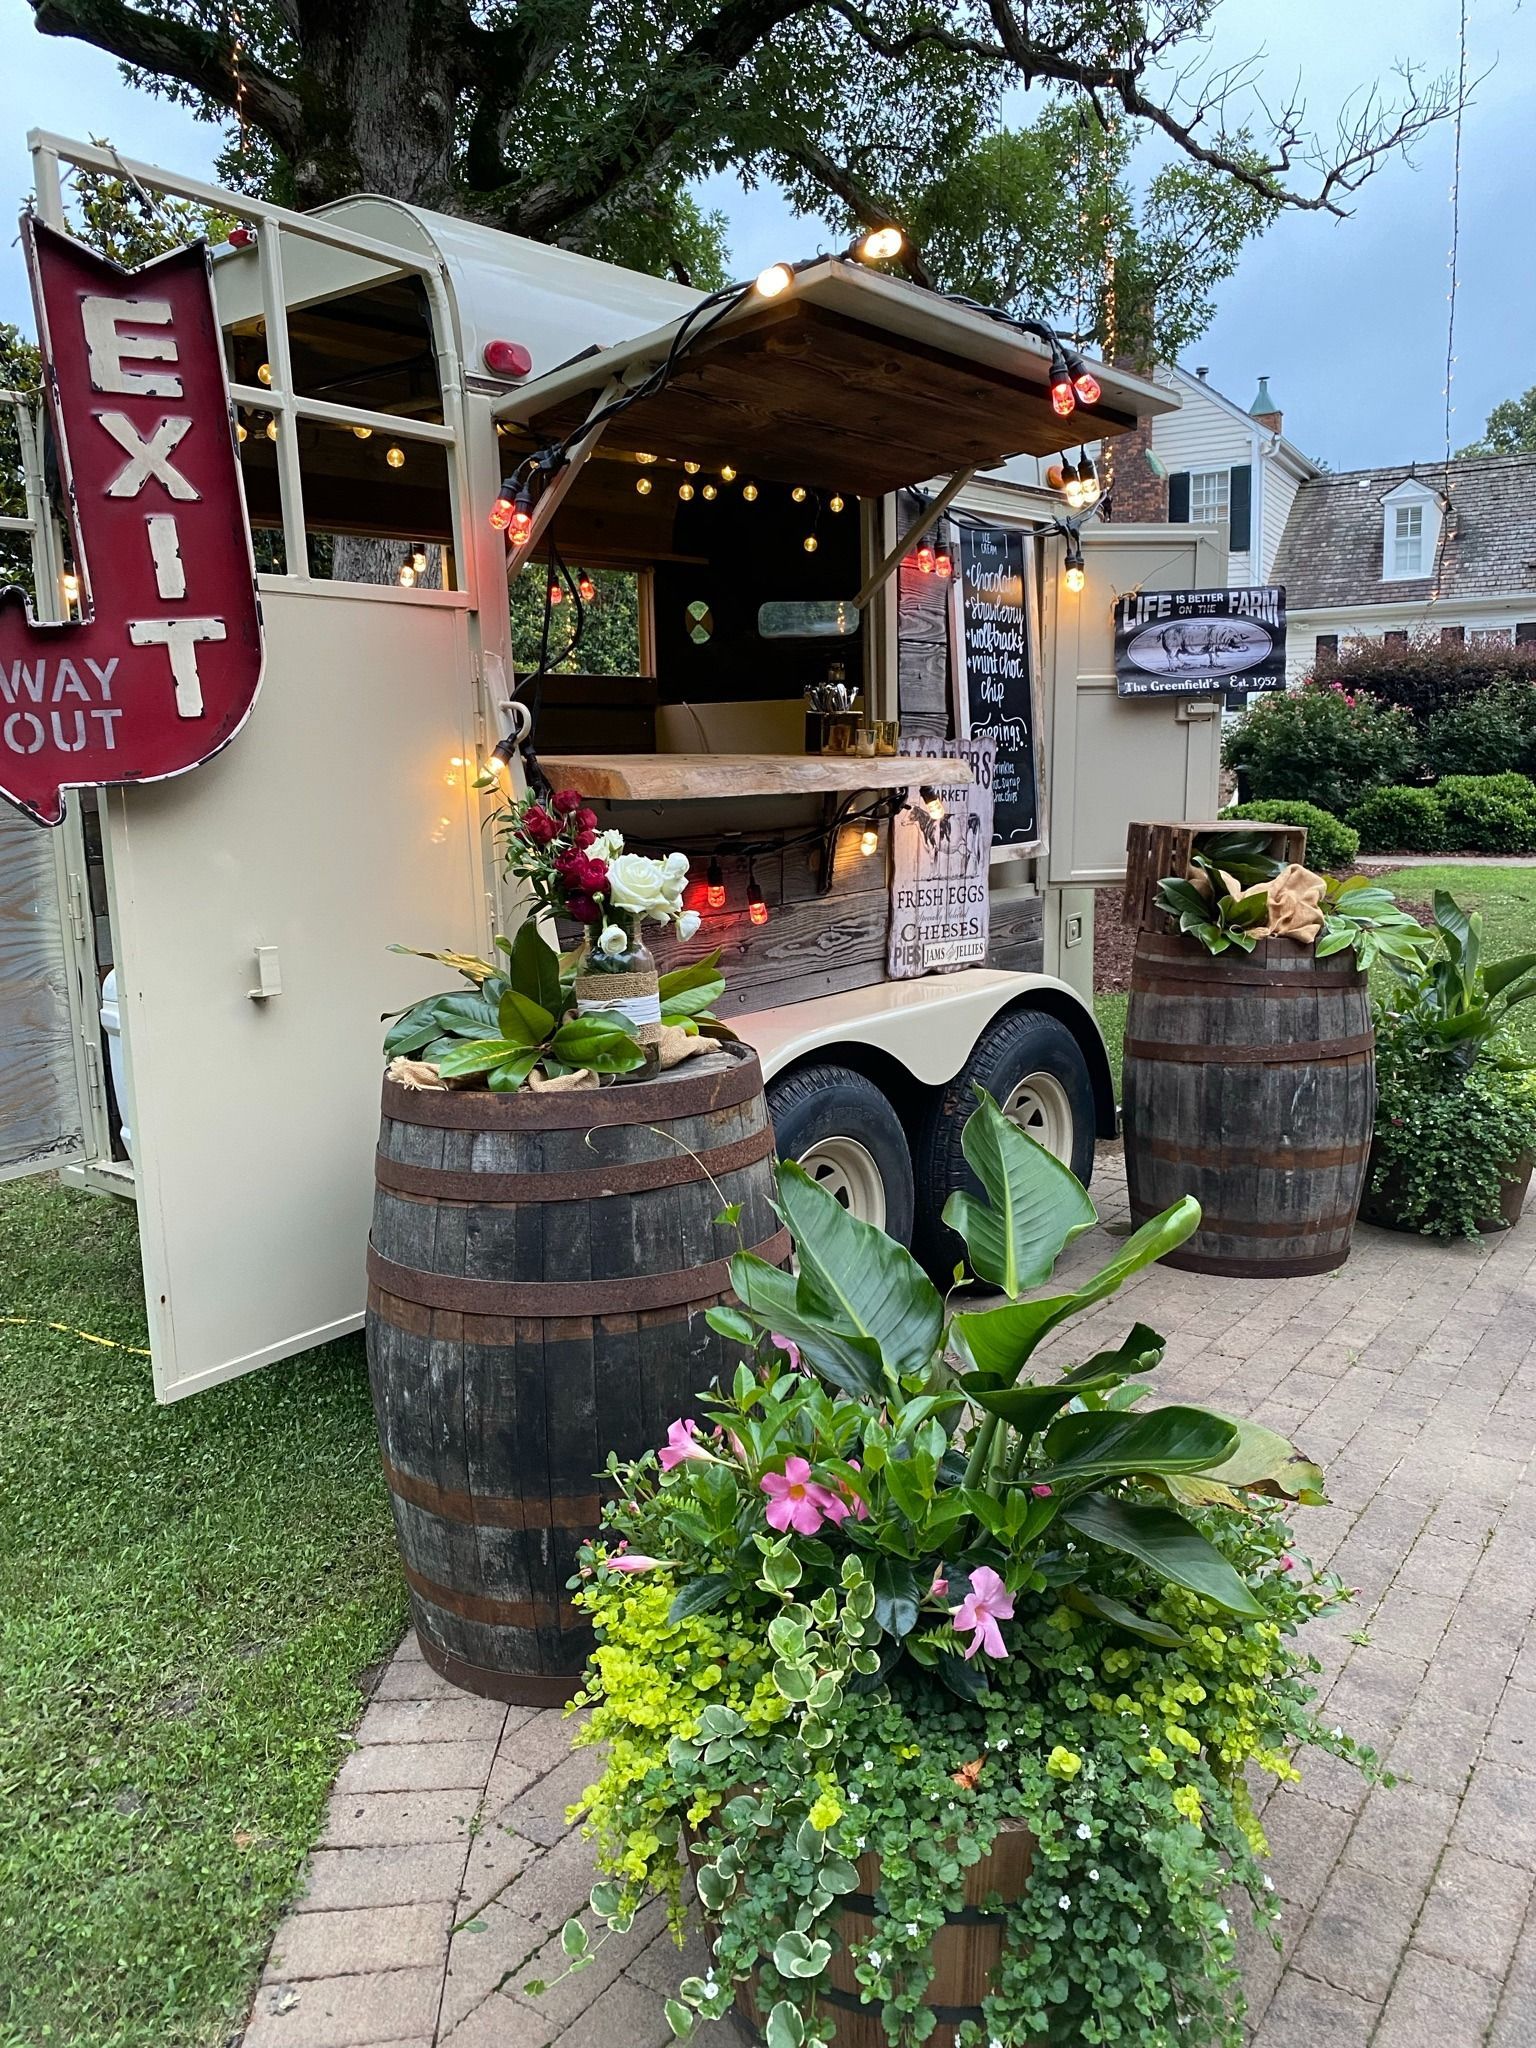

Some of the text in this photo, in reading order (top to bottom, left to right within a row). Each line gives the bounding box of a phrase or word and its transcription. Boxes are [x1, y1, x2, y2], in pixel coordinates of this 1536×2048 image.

[80, 295, 227, 718] EXIT
[981, 544, 997, 555] CREAM
[1176, 593, 1224, 604] IS BETTER
[1178, 604, 1216, 614] ON THE
[1228, 590, 1279, 628] FARM
[1123, 595, 1172, 632] LIFE
[972, 651, 998, 674] mint
[0, 658, 120, 703] WAY
[1124, 676, 1277, 694] The Greenfield's Est. 1952
[981, 676, 1004, 708] chip
[3, 709, 123, 754] OUT
[993, 761, 1015, 778] prinkles
[934, 789, 968, 802] ARKET
[897, 885, 984, 909] FRESH EGGS
[894, 945, 921, 967] PIES
[925, 947, 945, 964] JAMS
[955, 943, 984, 961] JELLIES
